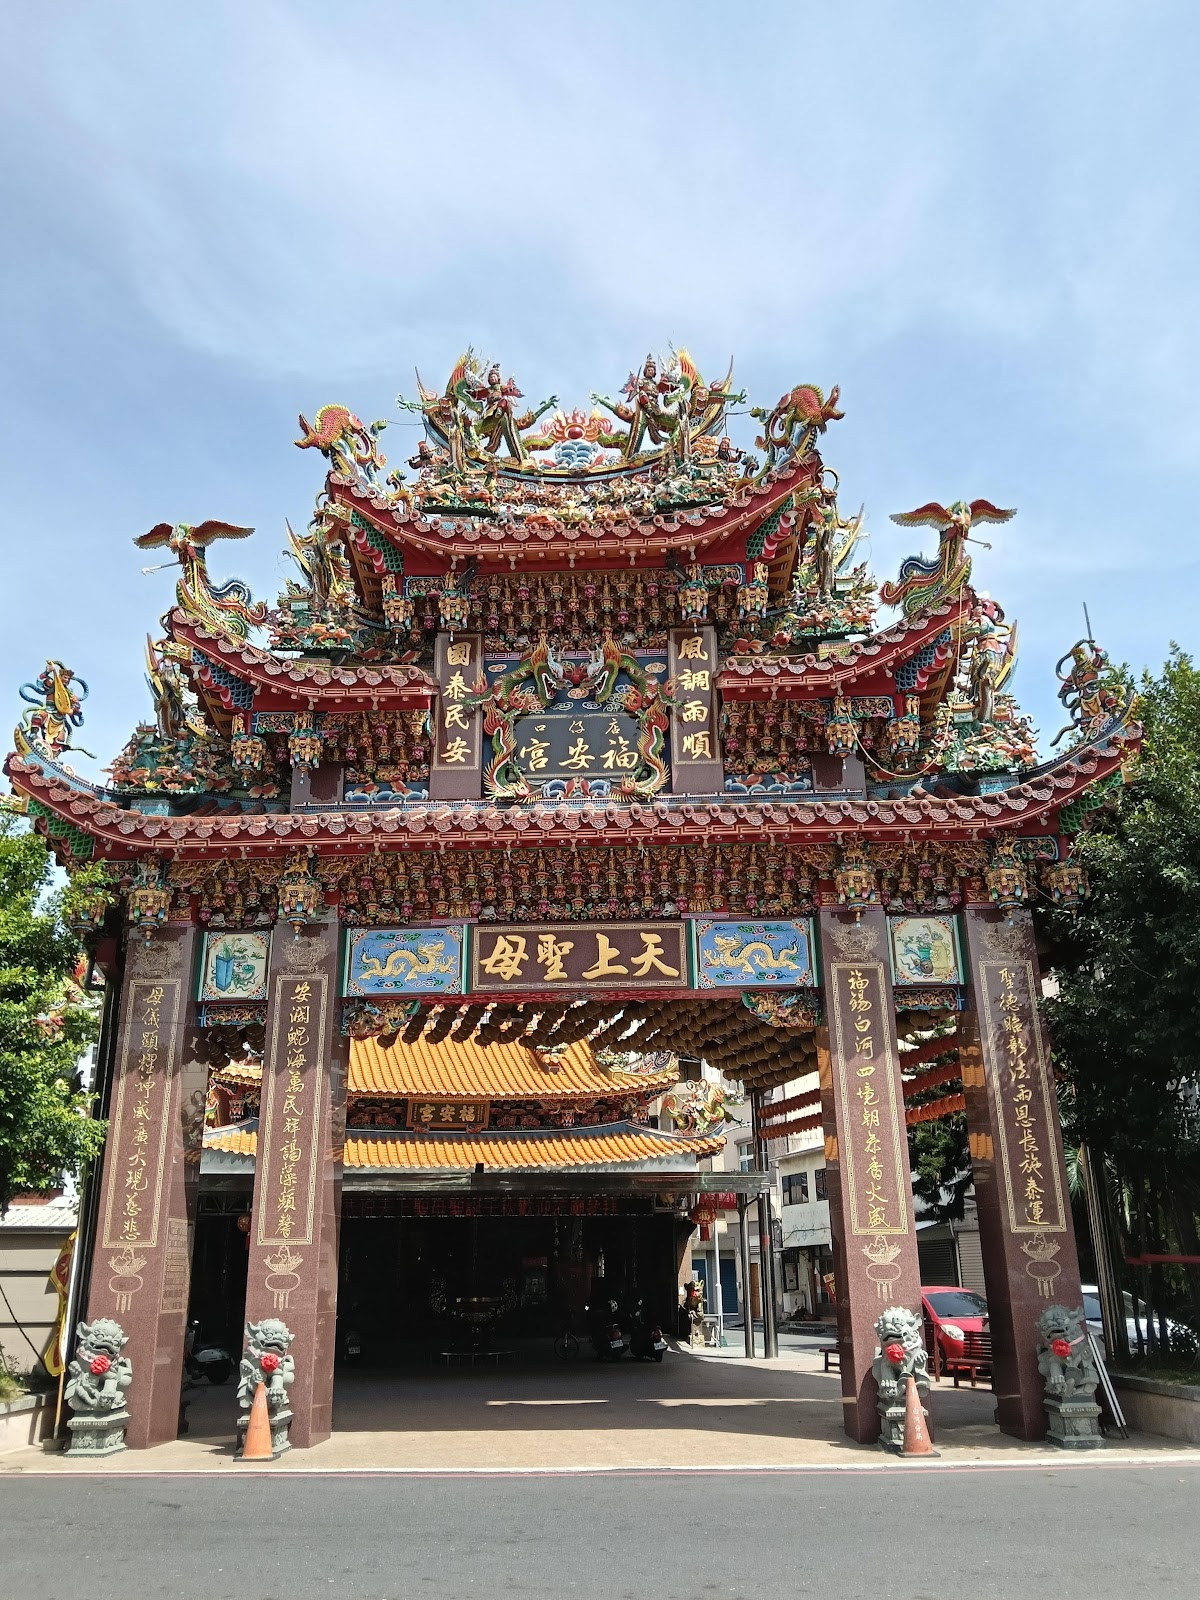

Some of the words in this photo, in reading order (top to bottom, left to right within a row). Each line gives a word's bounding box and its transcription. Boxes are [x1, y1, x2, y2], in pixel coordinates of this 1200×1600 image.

[440, 641, 473, 764] 國泰民安
[677, 635, 713, 760] 風調雨順
[519, 737, 640, 772] 福安宮
[479, 932, 680, 981] 天上聖母
[419, 1103, 476, 1123] 福安宮
